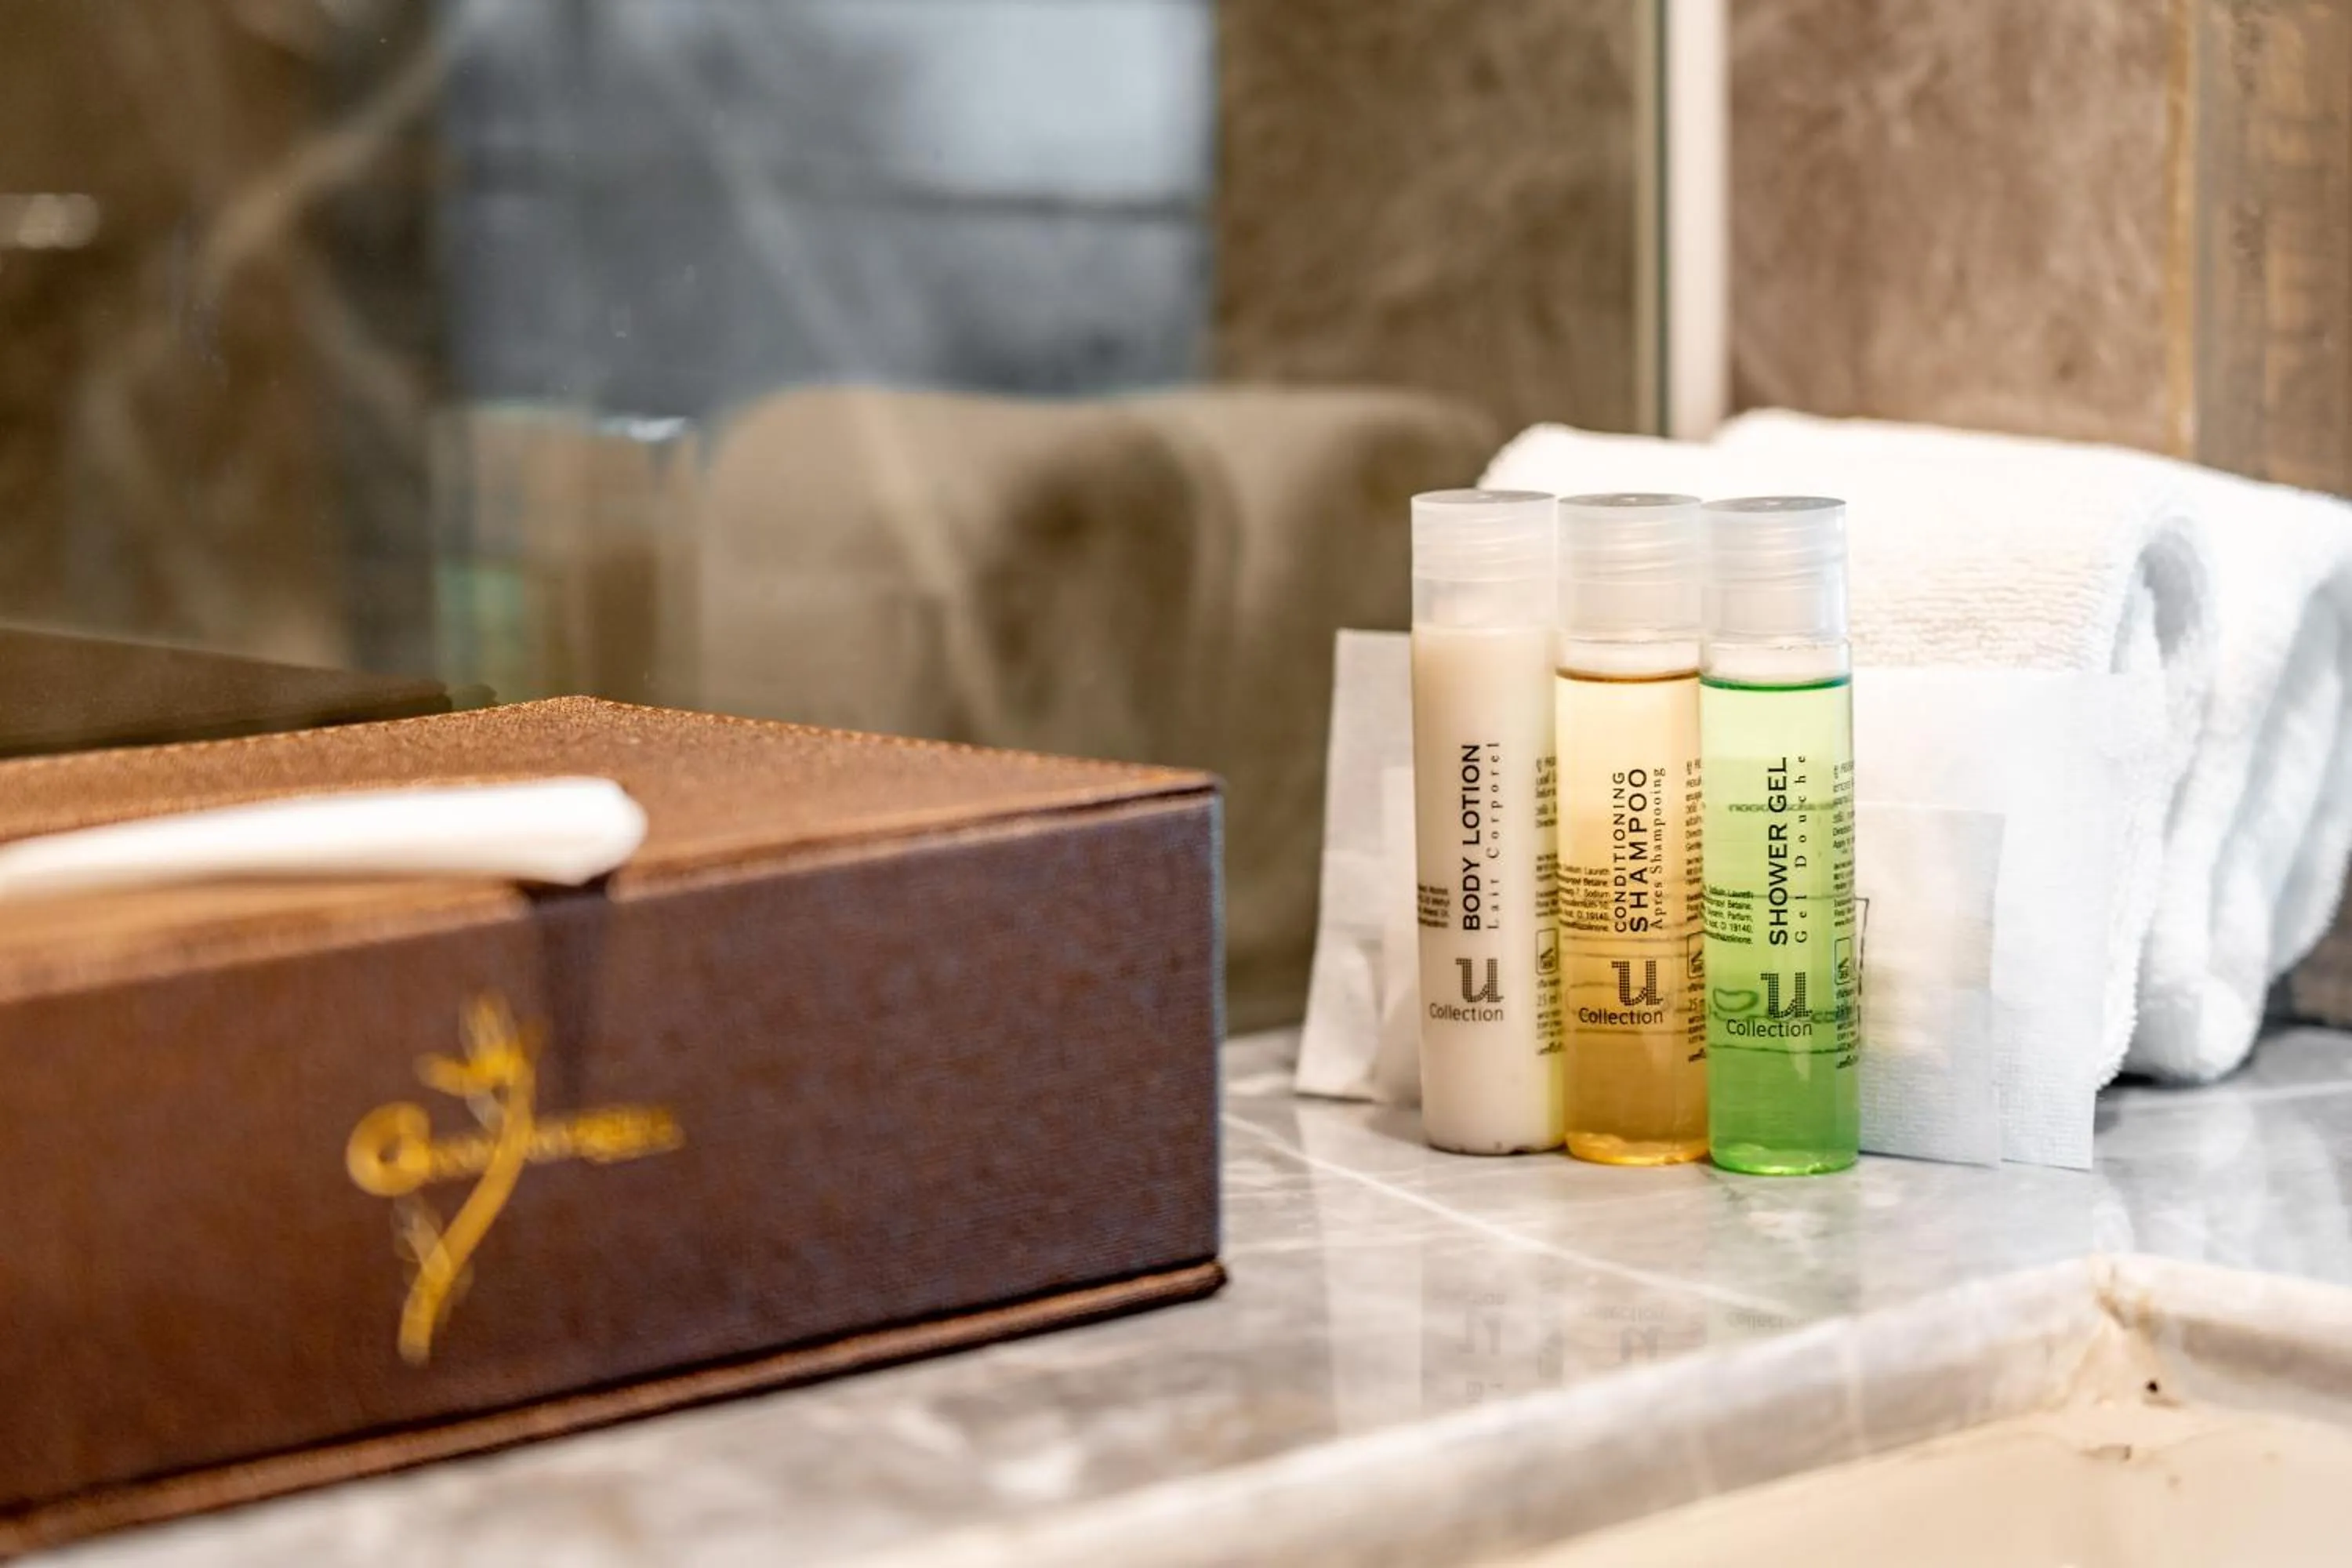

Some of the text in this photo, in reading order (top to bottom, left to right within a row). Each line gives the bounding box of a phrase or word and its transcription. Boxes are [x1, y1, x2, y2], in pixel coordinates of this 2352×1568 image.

[1461, 744, 1481, 931] BODY LOTION
[1486, 742, 1503, 859] Corporel
[1611, 771, 1627, 933] CONDITIONING
[1628, 768, 1649, 933] SHAMPOO
[1650, 768, 1666, 874] Shampooing
[1767, 757, 1788, 946] SHOWER GEL
[1794, 755, 1808, 944] Gel Douche
[1429, 1001, 1504, 1022] Collection
[1578, 1007, 1663, 1025] Collection
[1726, 1018, 1813, 1038] Collection
